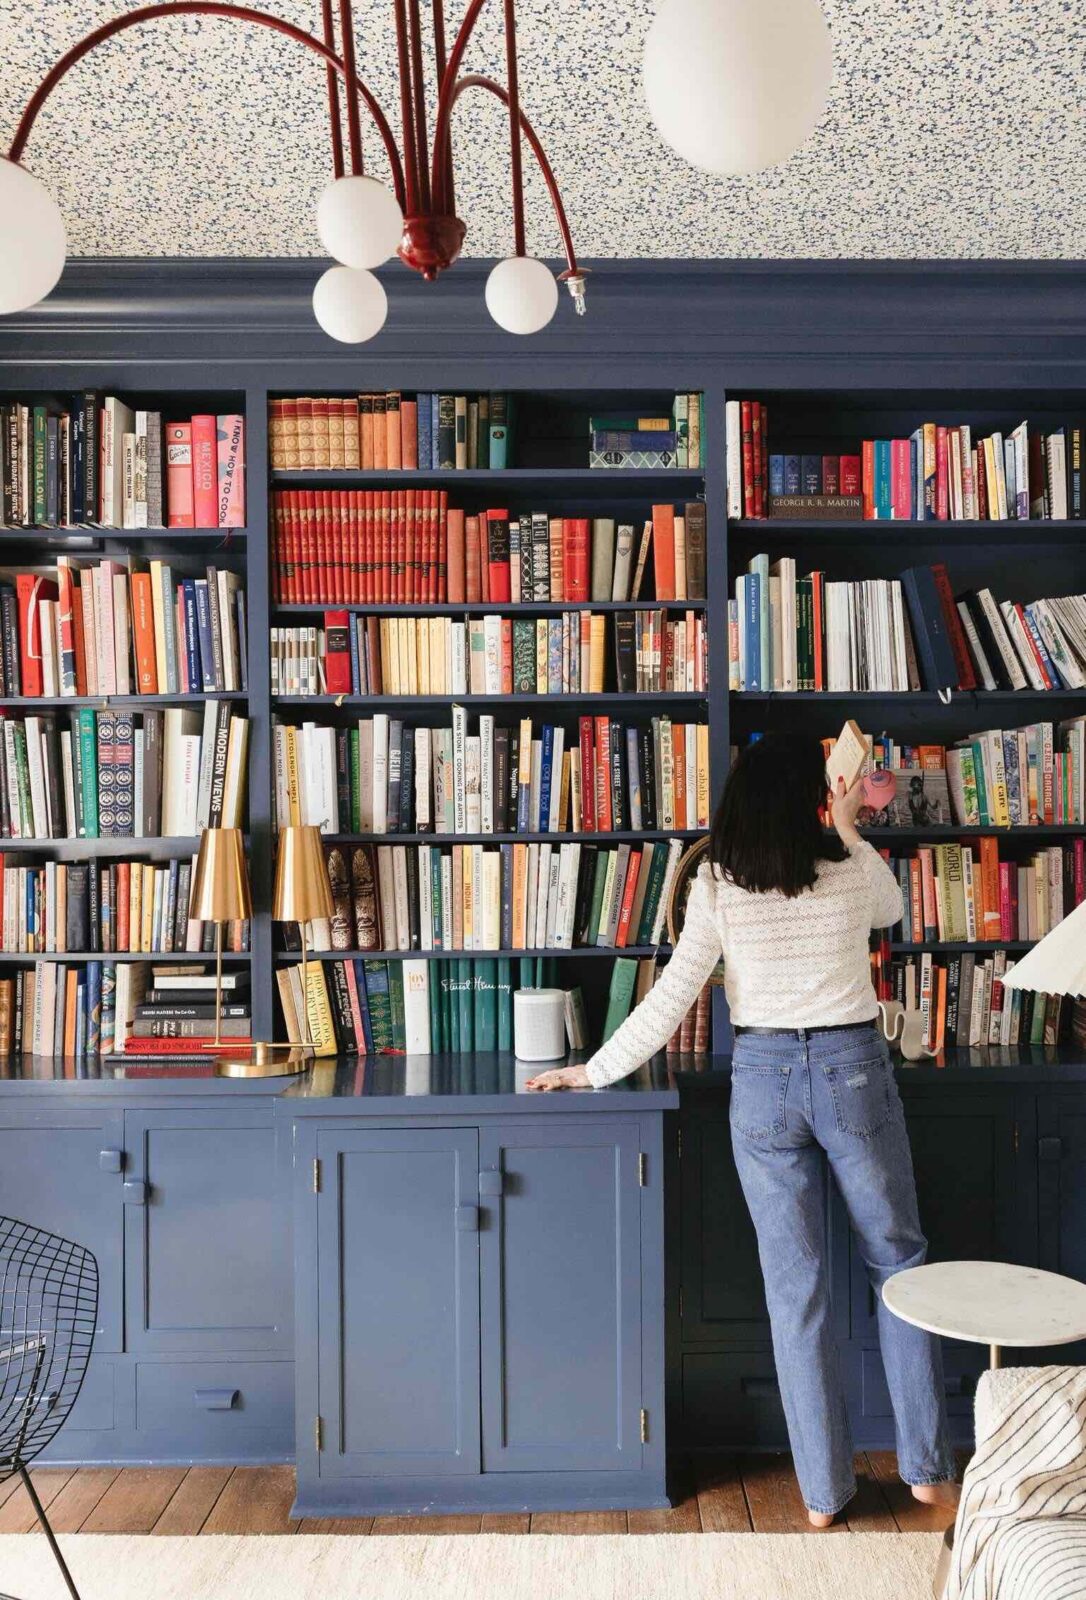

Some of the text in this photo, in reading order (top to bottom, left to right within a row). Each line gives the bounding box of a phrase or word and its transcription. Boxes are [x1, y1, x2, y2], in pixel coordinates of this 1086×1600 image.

[230, 426, 241, 453] KNOW
[202, 442, 211, 489] MEXICO
[226, 456, 235, 478] HOW
[224, 482, 232, 494] TO
[220, 497, 229, 523] COOK
[1030, 626, 1048, 661] DO OVER
[215, 728, 228, 774] MODERN
[390, 750, 400, 782] GJELINA
[510, 768, 518, 798] Nopalito
[597, 722, 610, 818] ALPINE COOKING
[212, 778, 223, 812] VIEWS
[998, 786, 1006, 808] care
[947, 845, 960, 881] WORLD
[335, 962, 348, 988] great
[312, 975, 331, 1044] HOW TO COOK
[341, 993, 352, 1028] recipes
